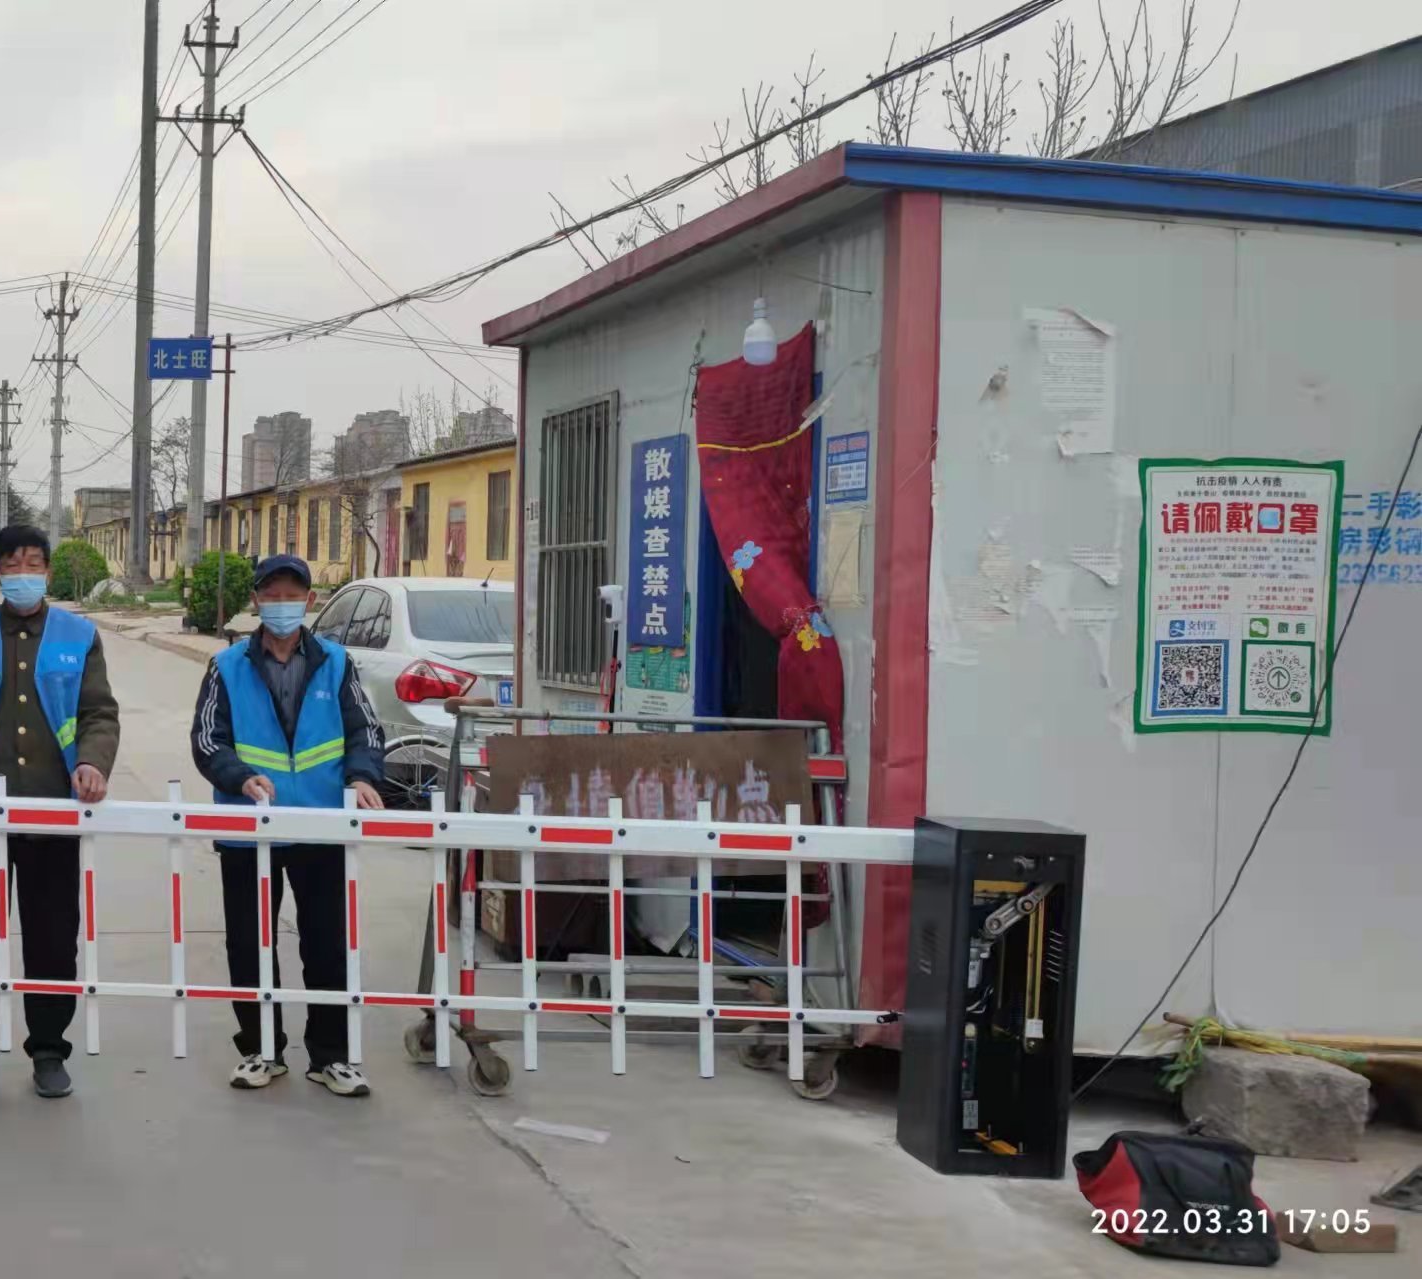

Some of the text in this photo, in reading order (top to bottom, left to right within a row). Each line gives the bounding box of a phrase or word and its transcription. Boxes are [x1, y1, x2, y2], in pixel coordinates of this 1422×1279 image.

[153, 348, 207, 369] 北士旺
[1196, 476, 1283, 488] 抗击疫情 人人有责
[1161, 502, 1319, 535] 请佩戴口罩
[642, 447, 671, 635] 散煤查禁点
[1188, 620, 1217, 631] 支付宝
[1278, 622, 1306, 635] 微信
